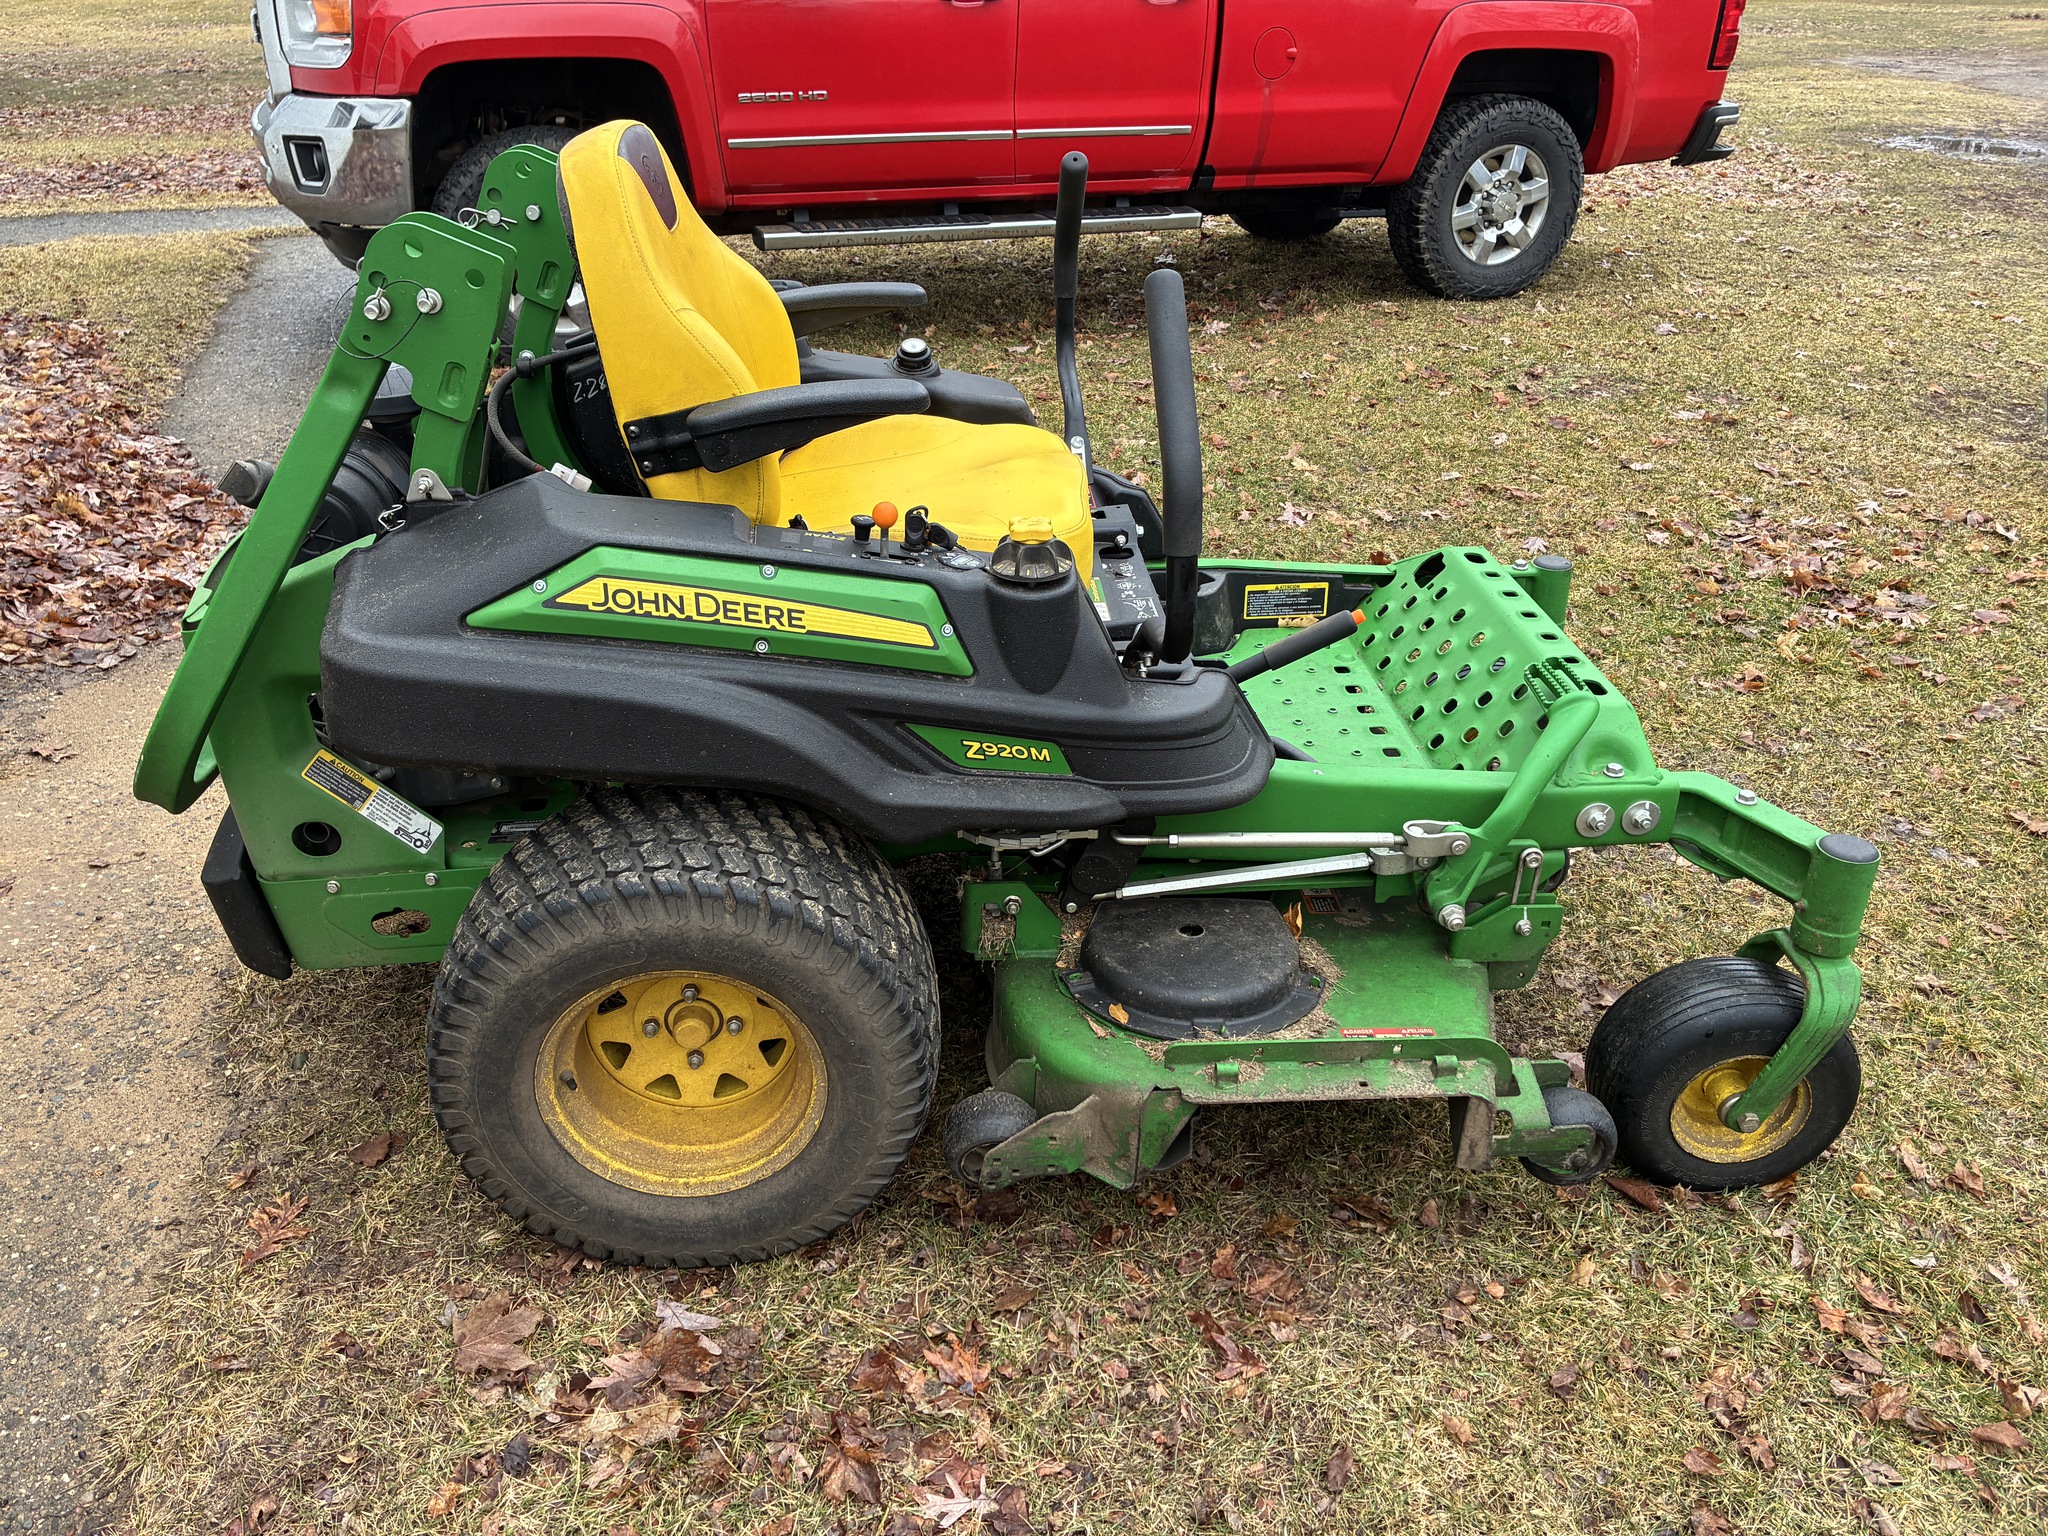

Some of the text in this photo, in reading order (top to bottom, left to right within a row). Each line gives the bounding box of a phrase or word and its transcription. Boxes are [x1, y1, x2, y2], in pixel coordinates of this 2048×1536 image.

[738, 90, 828, 104] 2500 HD
[591, 582, 806, 630] JOHN DEERE
[962, 740, 1052, 762] Z920M
[336, 762, 366, 783] CAUTION
